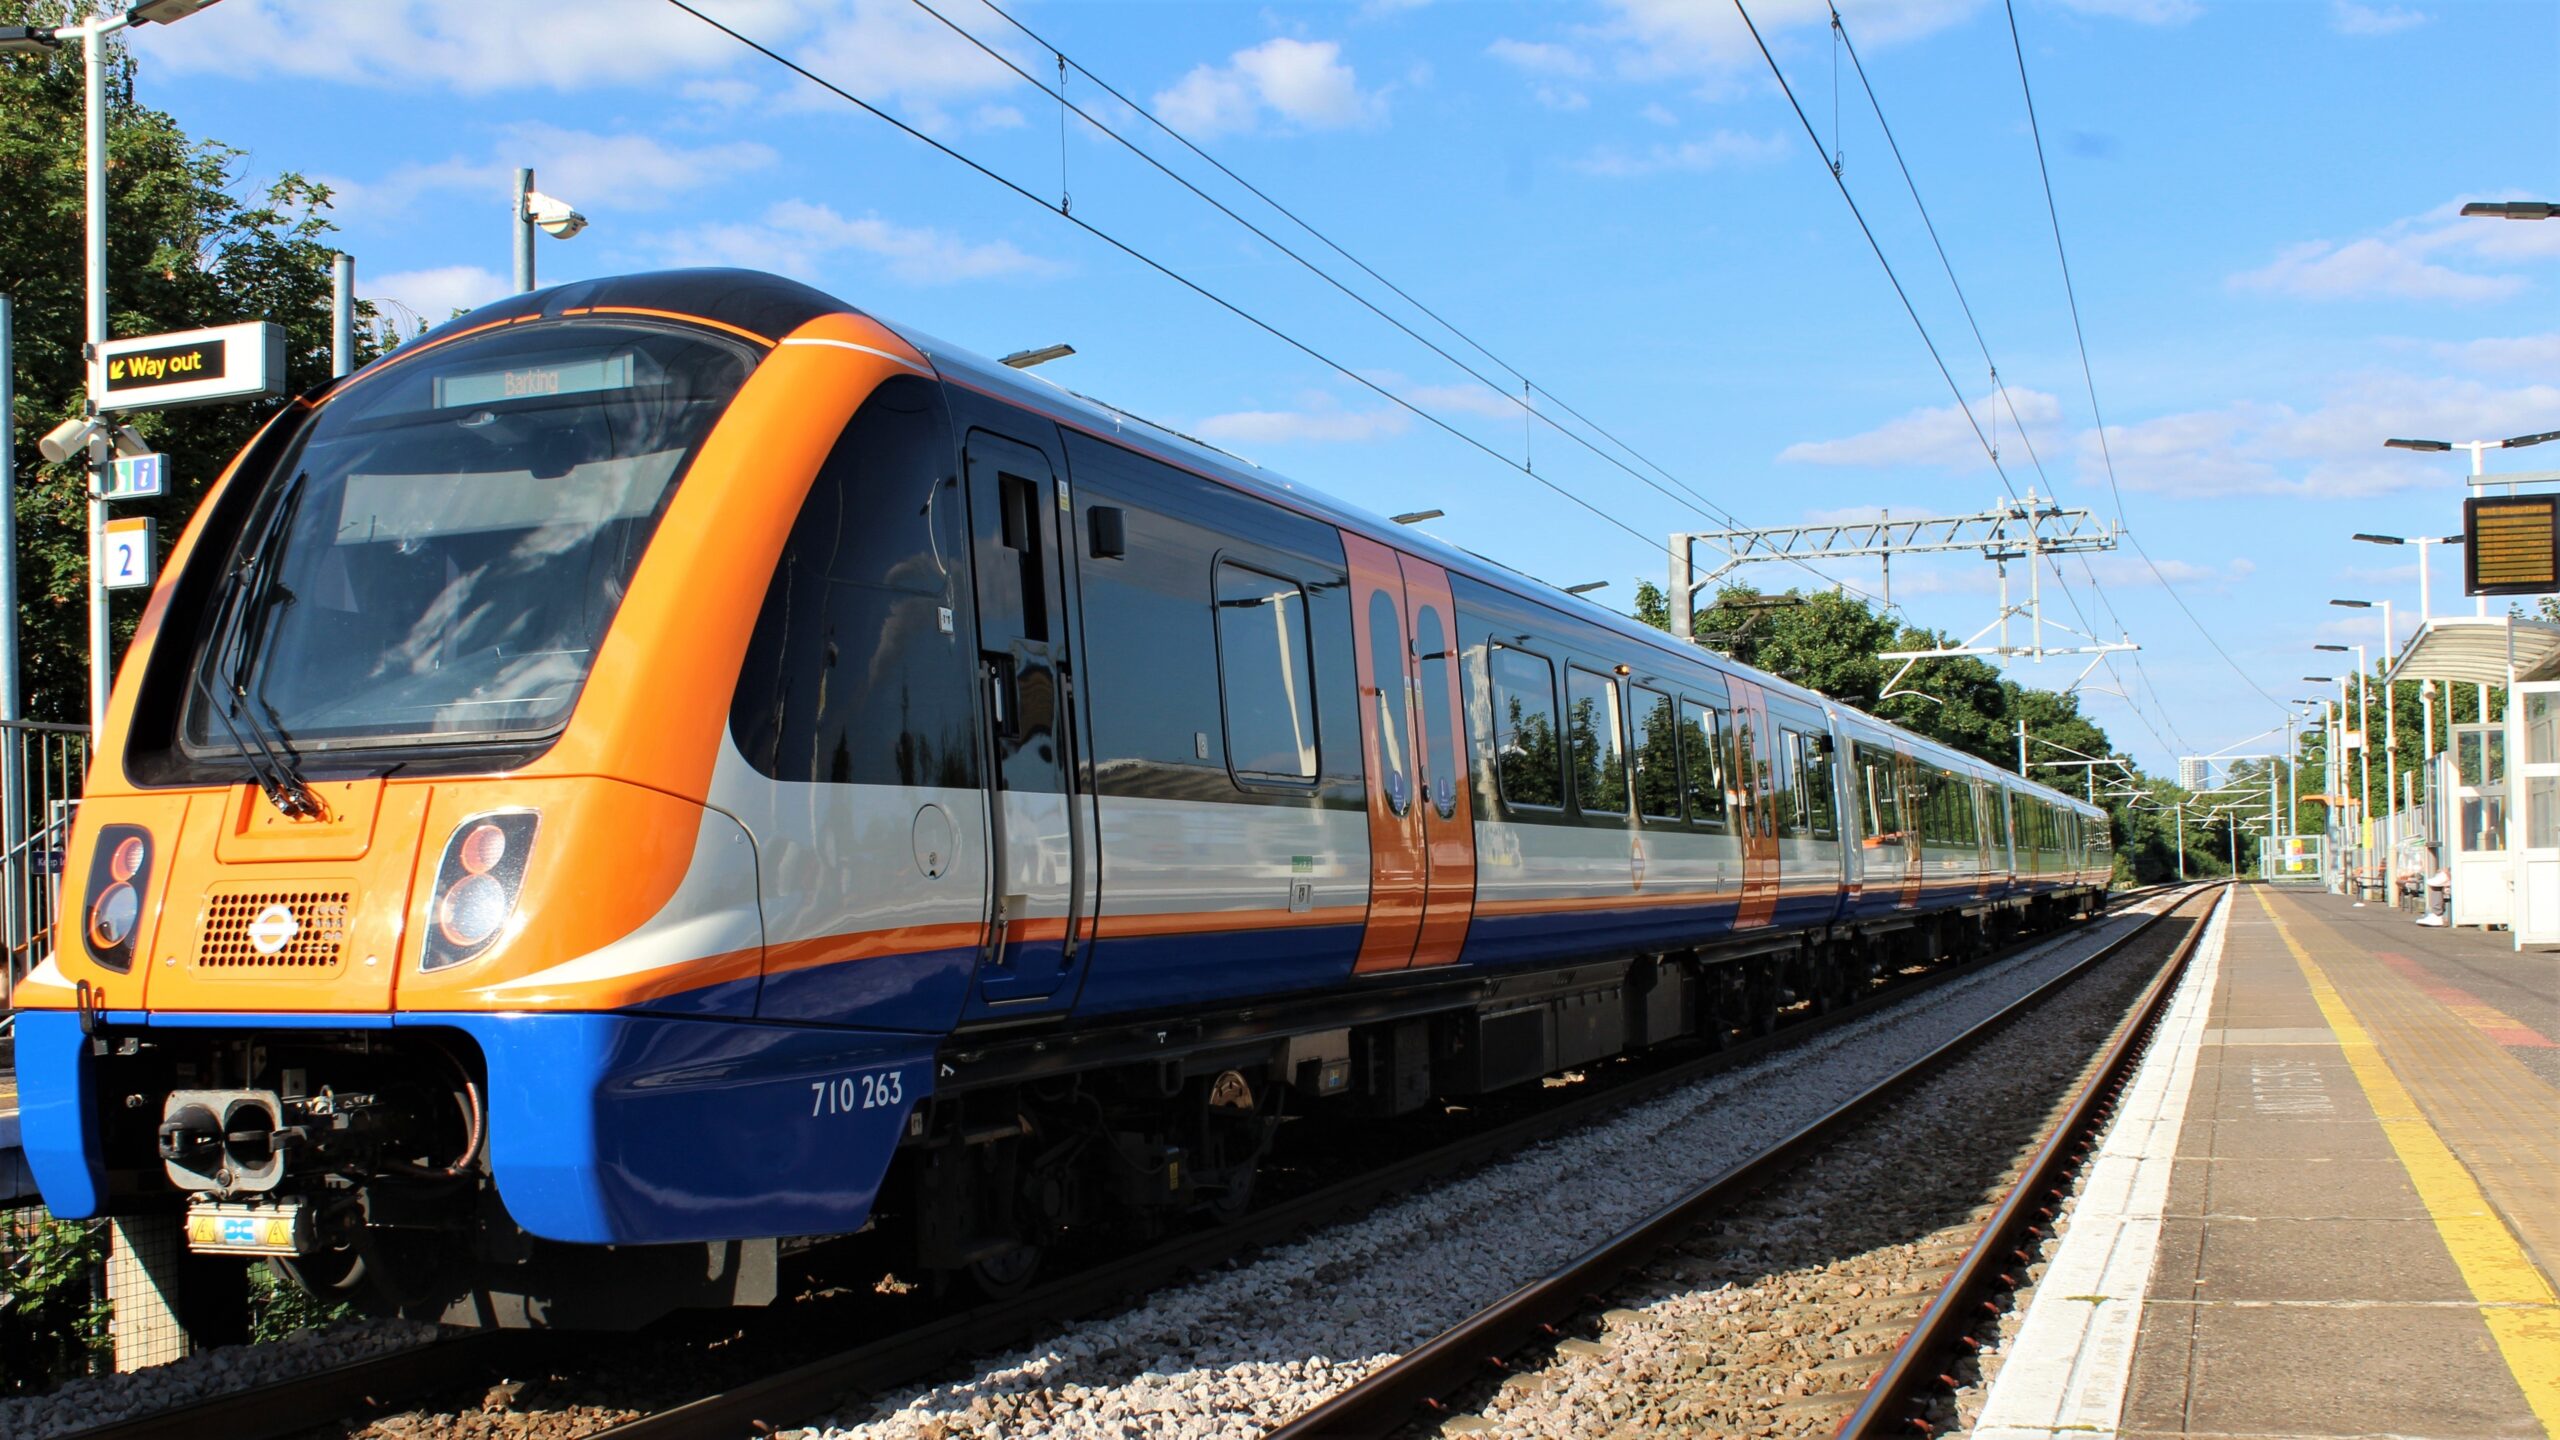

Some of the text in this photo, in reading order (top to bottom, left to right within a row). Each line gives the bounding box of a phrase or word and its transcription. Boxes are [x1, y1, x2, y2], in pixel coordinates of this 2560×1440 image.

[128, 351, 201, 379] Way out
[504, 368, 559, 396] Barking
[119, 544, 133, 576] 2
[811, 1071, 902, 1117] 710 263
